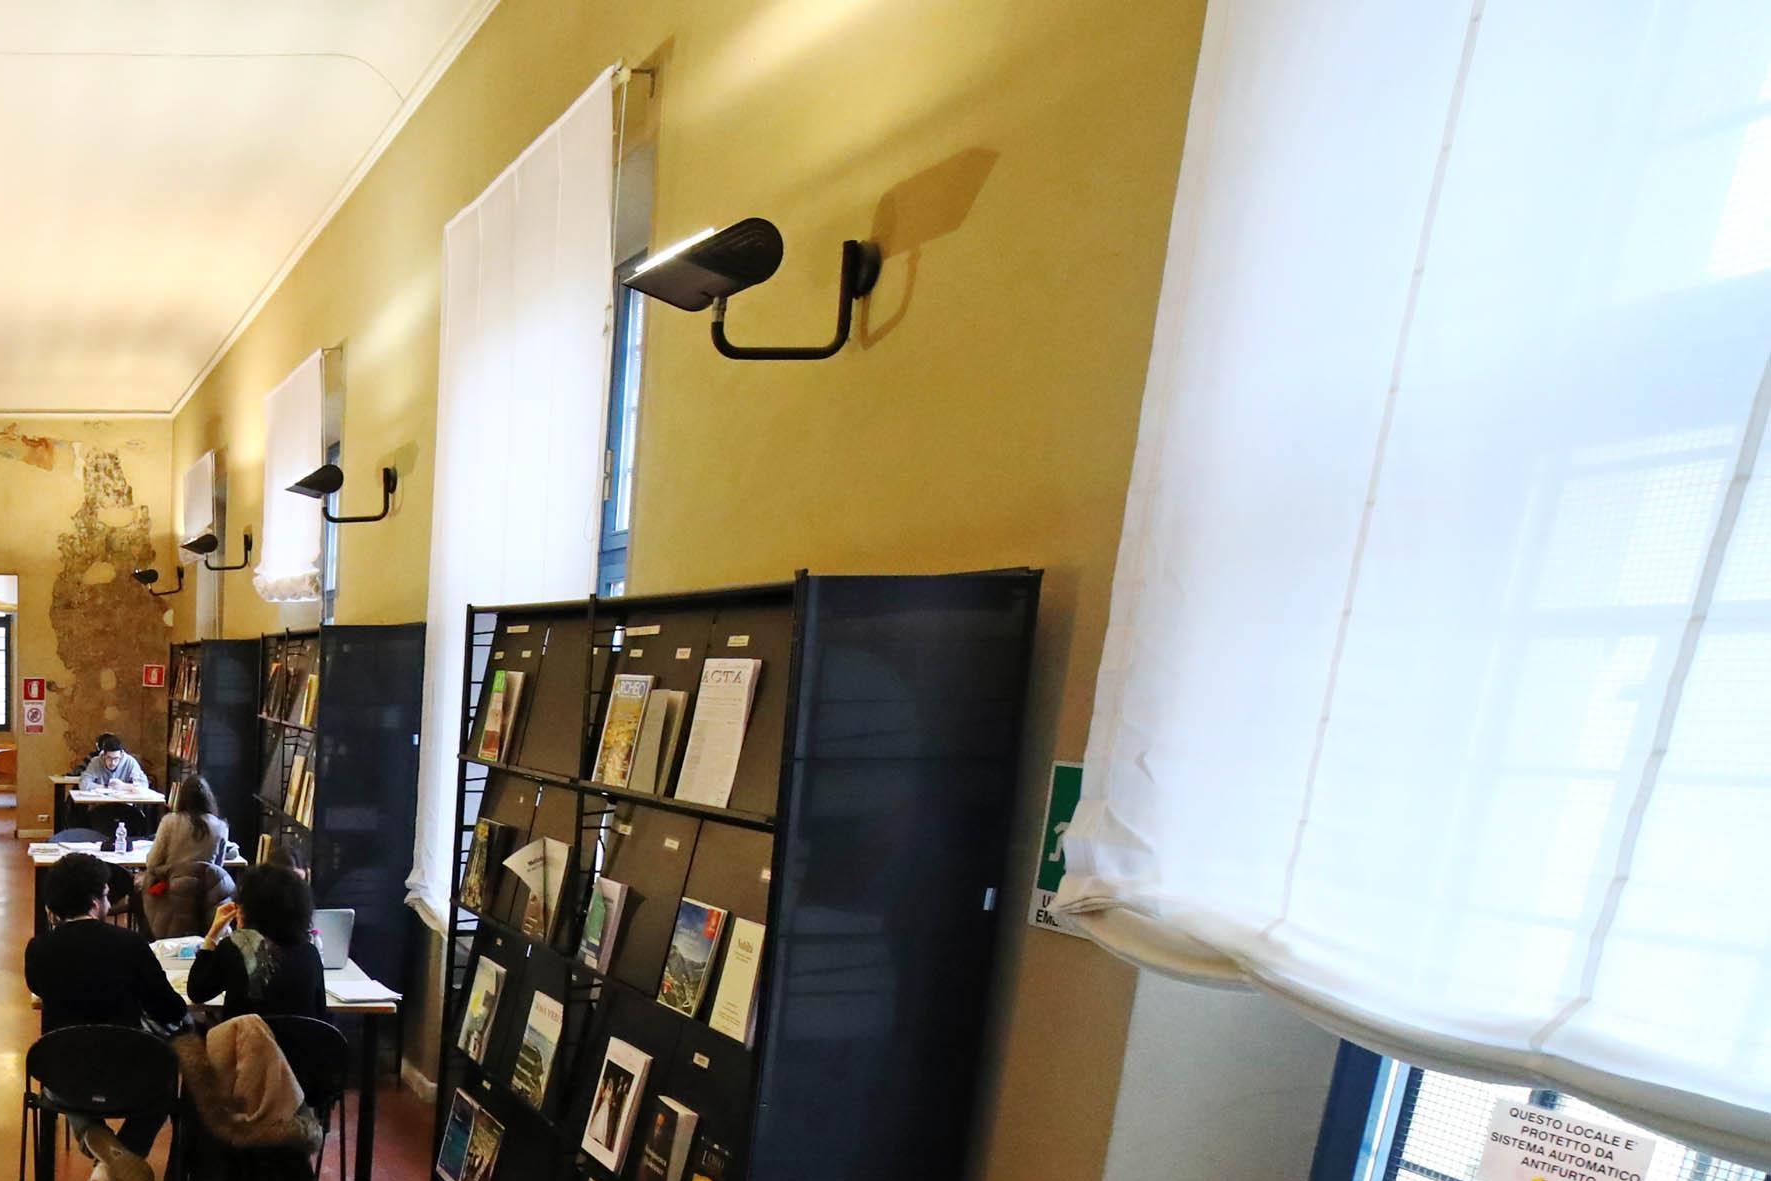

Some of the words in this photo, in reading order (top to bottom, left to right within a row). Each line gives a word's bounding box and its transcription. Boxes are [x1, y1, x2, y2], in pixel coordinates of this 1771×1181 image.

[1490, 1132, 1545, 1156] SISTEMA
[1509, 1107, 1563, 1130] QUESTO
[1566, 1123, 1621, 1147] LOCALE
[1521, 1125, 1592, 1154] PROTETTO
[1594, 1147, 1614, 1161] DA
